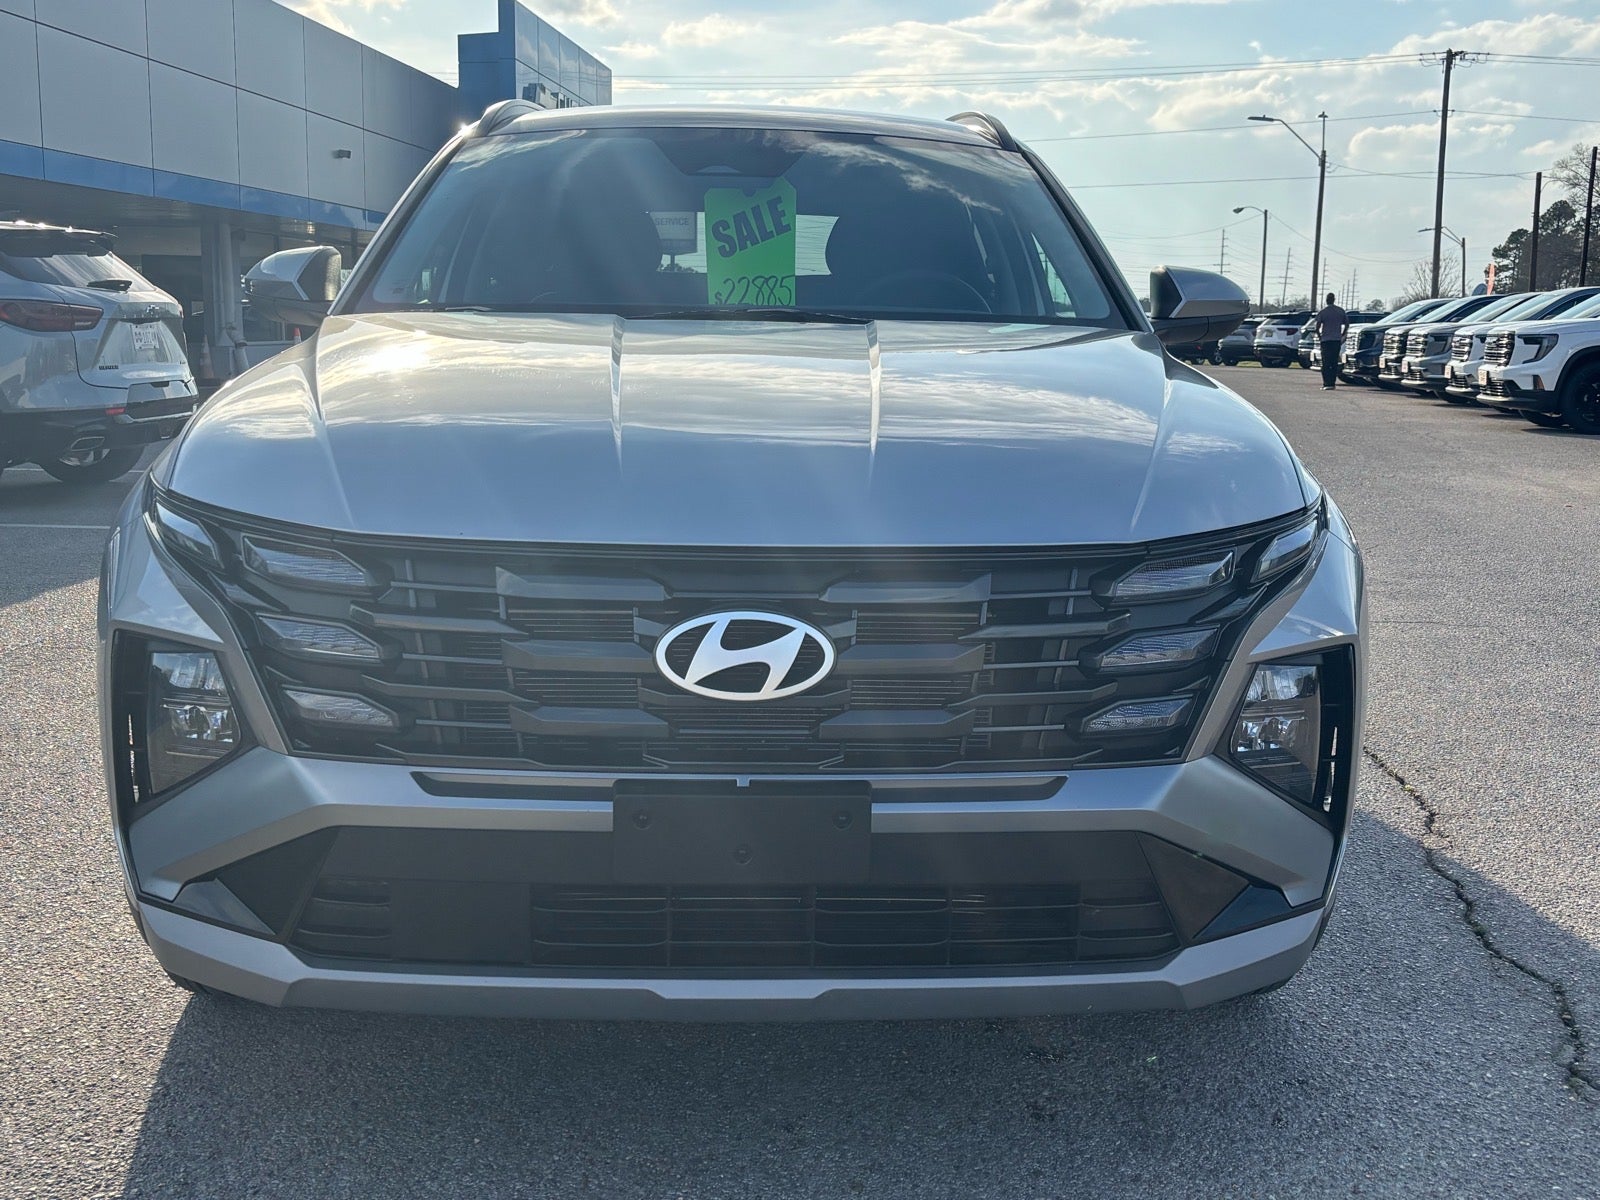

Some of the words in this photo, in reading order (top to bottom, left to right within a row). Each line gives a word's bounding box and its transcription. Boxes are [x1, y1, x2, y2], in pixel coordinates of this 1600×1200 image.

[654, 217, 689, 226] SERVICE
[711, 196, 792, 259] SALE
[715, 275, 795, 306] $22885
